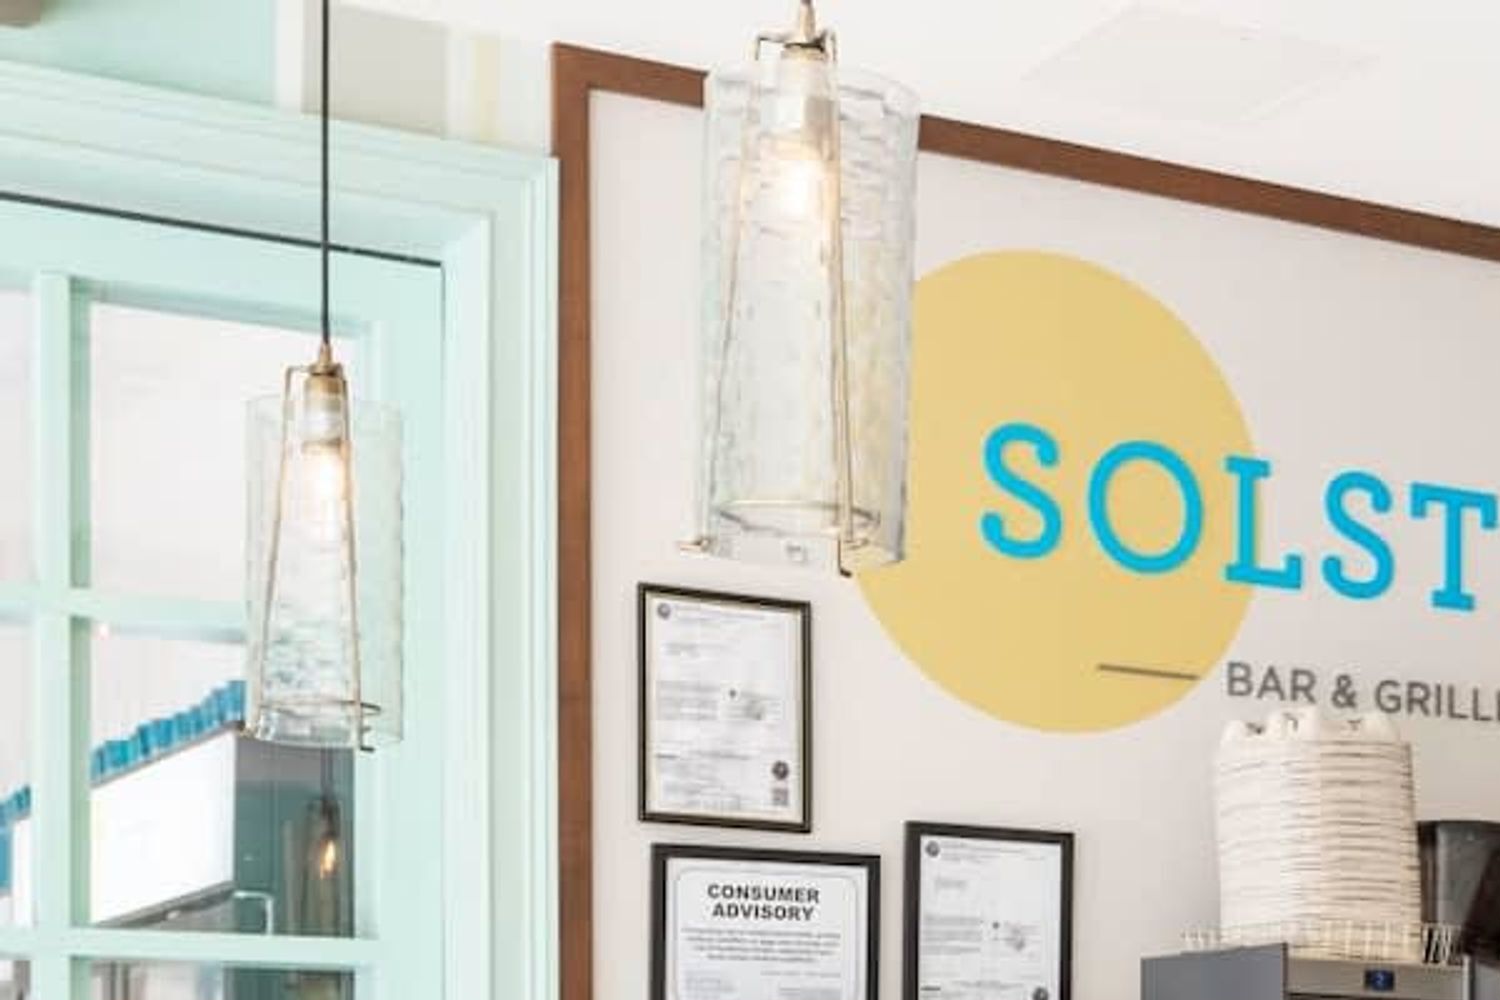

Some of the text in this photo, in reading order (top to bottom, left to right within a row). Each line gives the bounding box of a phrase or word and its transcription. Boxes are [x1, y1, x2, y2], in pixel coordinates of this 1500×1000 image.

[1228, 662, 1315, 705] BAR
[1331, 673, 1360, 711] &
[707, 884, 821, 904] CONSUMER
[712, 903, 815, 921] ADVISORY
